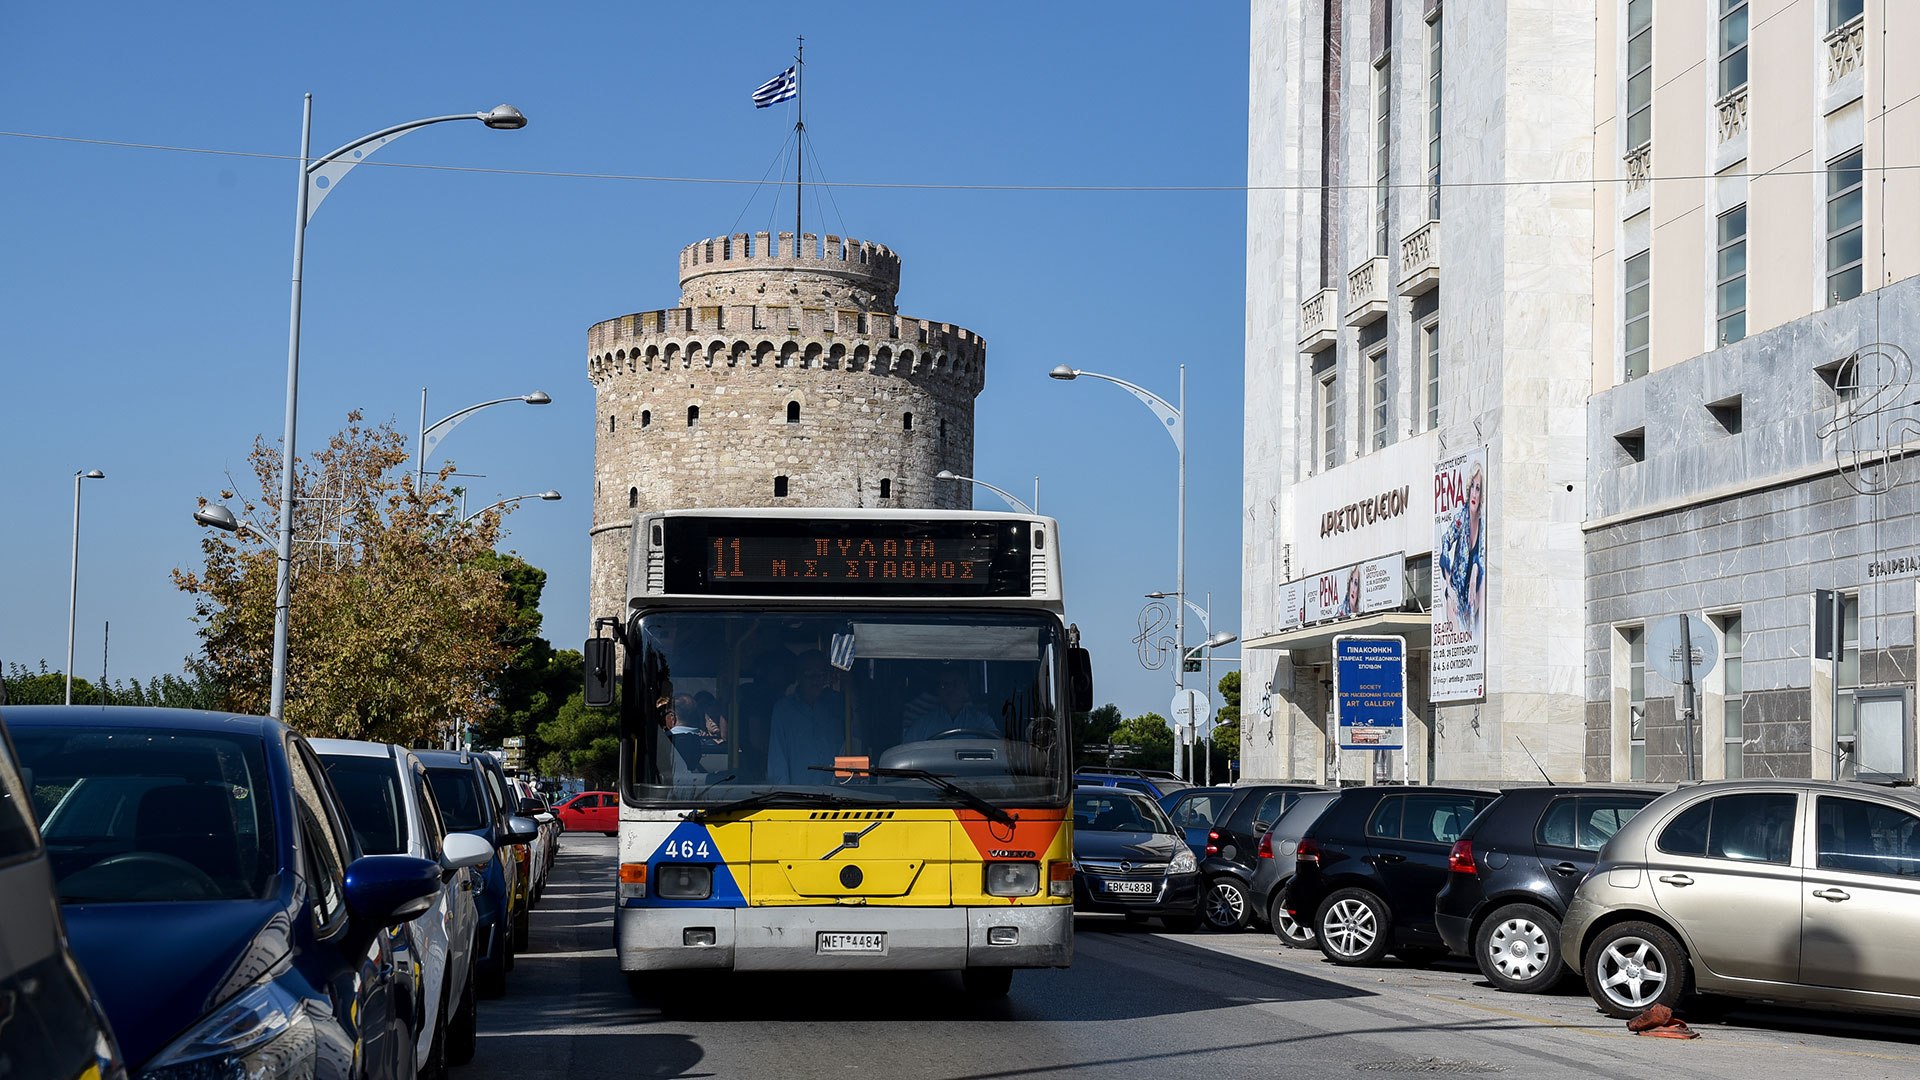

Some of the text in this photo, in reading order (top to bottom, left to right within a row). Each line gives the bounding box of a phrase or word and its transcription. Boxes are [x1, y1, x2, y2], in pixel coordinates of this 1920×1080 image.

[1434, 469, 1465, 514] ΡΕΝΑ
[1320, 485, 1409, 539] ΑΡΙΣΤΟΤΕΛΕΙΟΝ
[713, 538, 934, 577] 11 ΠΥΛΑΙΑ
[846, 560, 974, 578] ΣΤΑΘΜΟΣ
[1319, 575, 1339, 608] ΡΕΝΑ
[665, 840, 710, 858] 464
[989, 850, 1036, 858] VOLVO
